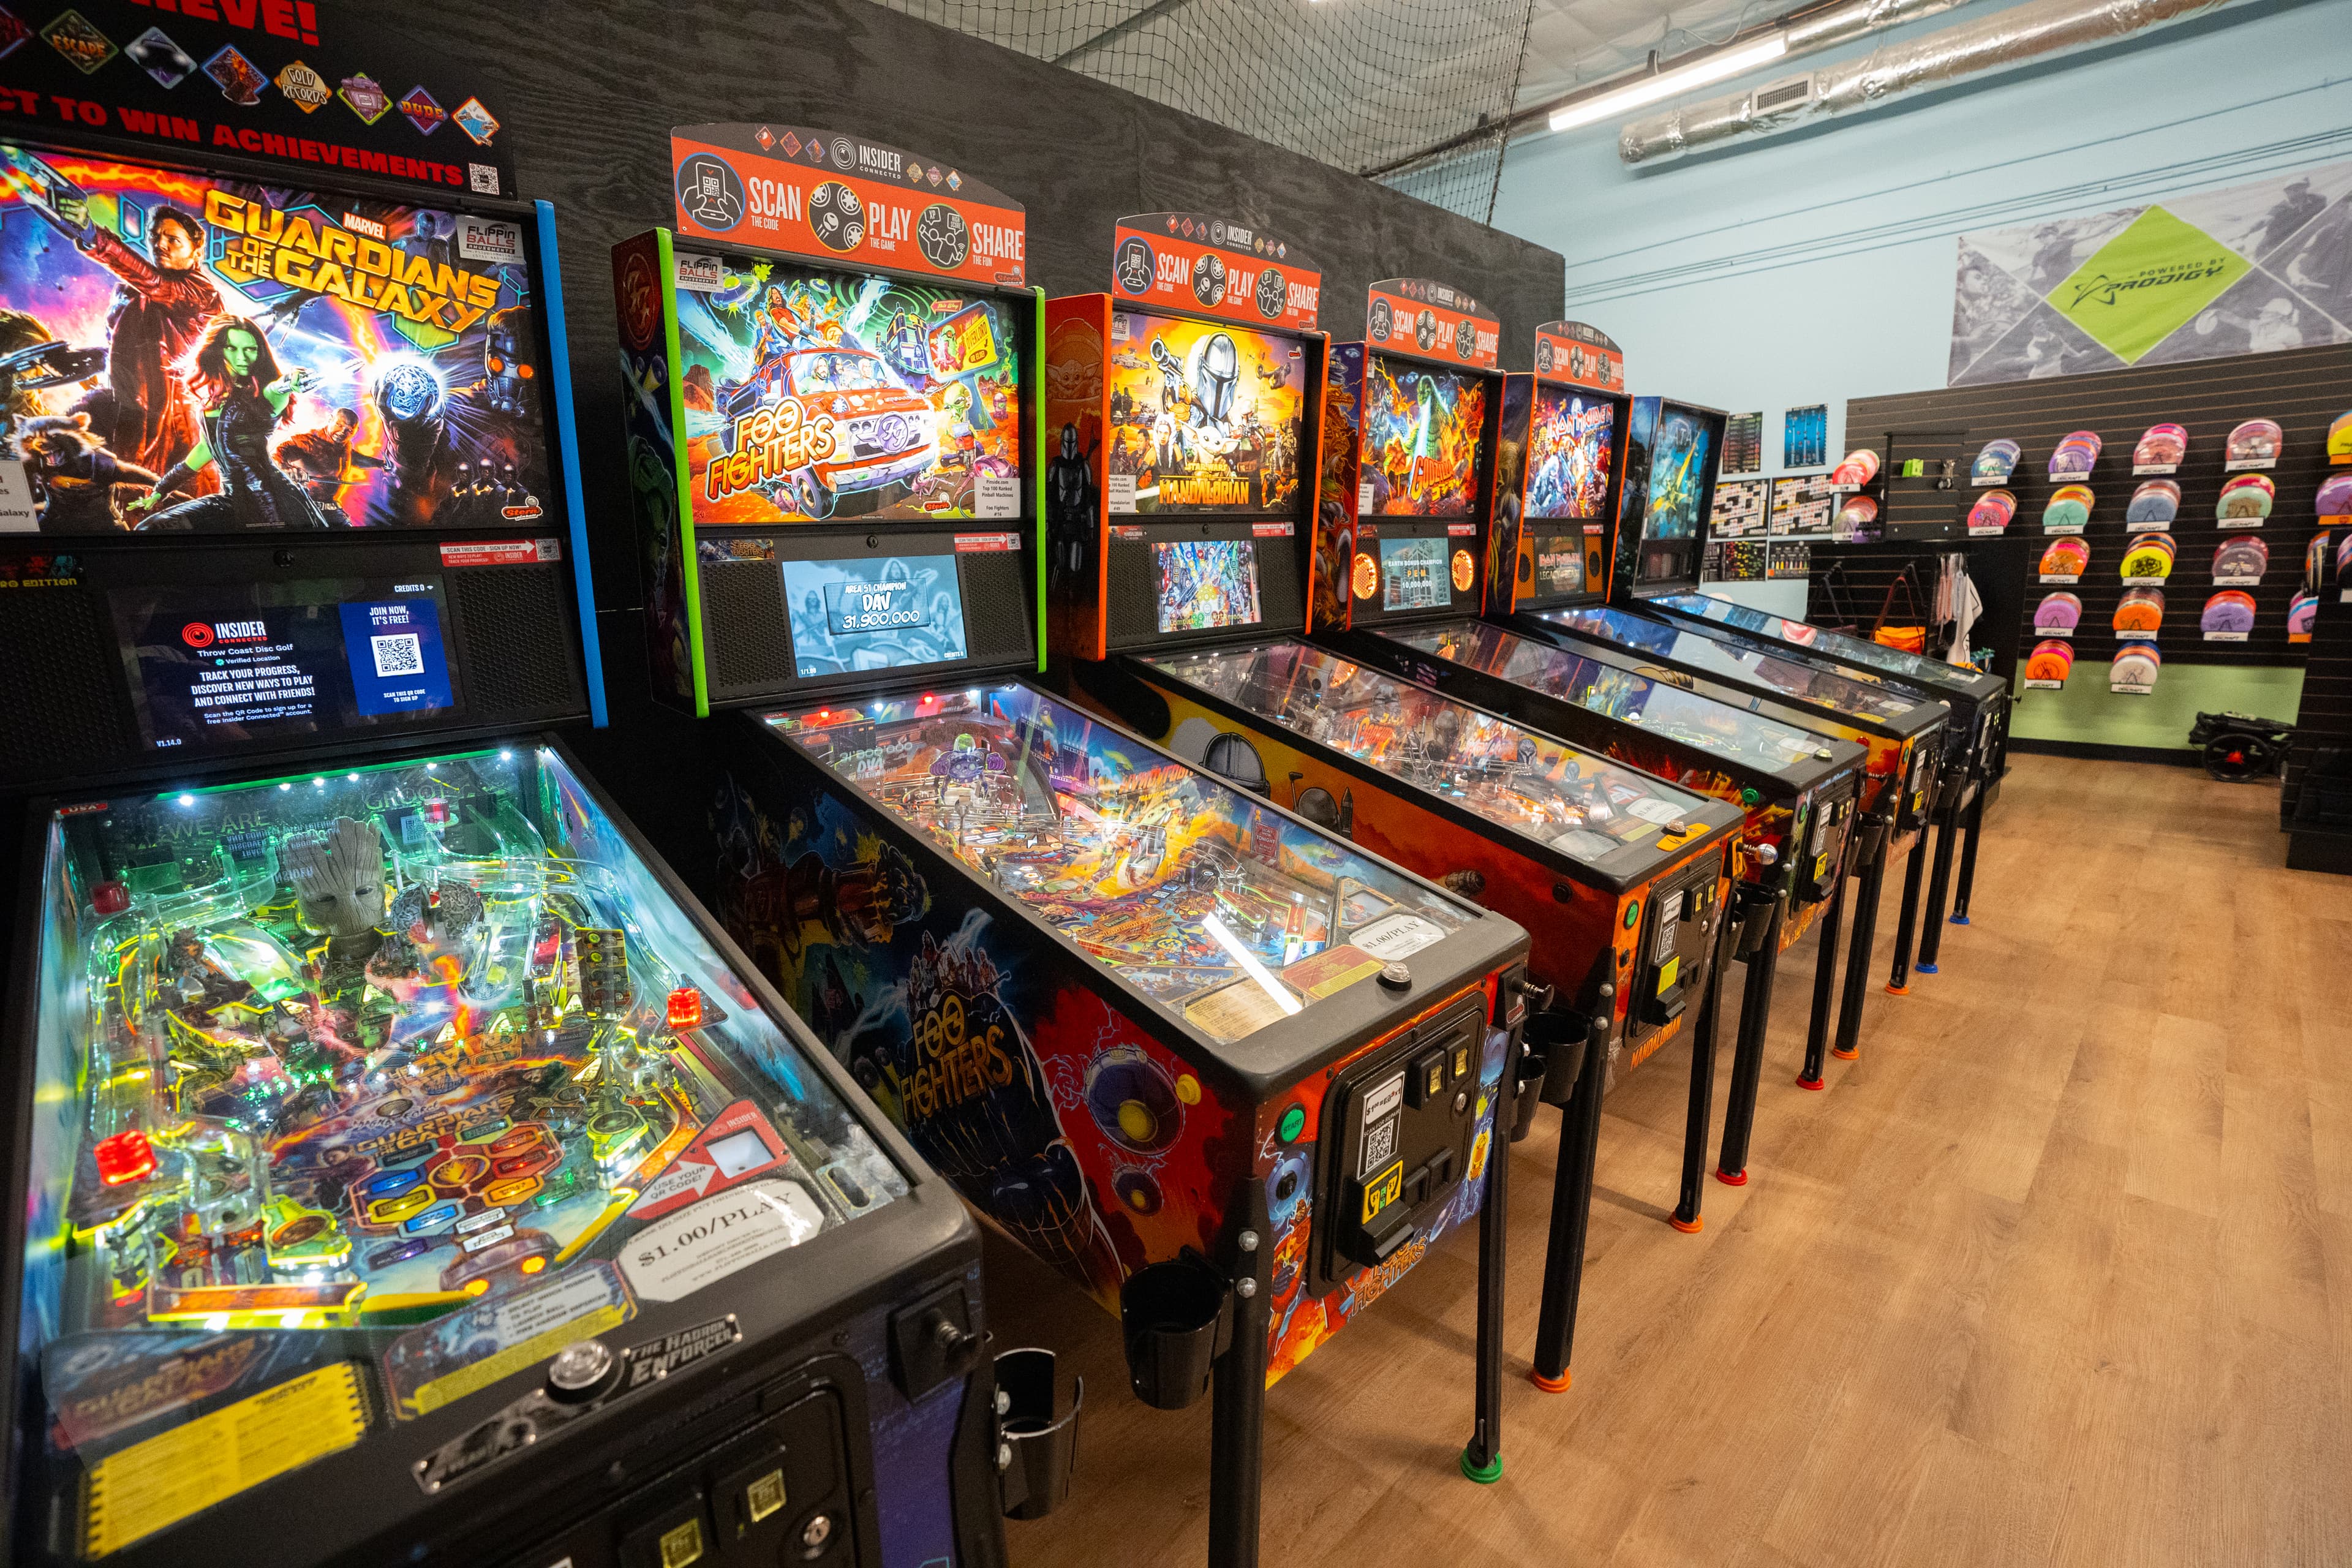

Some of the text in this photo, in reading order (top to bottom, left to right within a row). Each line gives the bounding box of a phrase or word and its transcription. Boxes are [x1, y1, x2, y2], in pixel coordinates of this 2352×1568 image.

[287, 67, 315, 87] GOLD
[282, 84, 328, 105] RECORDS
[401, 100, 445, 122] DUDE
[51, 96, 464, 186] TO WIN ACHIEVEMENTS
[859, 145, 901, 173] INSIDER
[859, 166, 902, 179] CONNECTED
[748, 176, 1023, 262] SCAN PLAY SHARE
[751, 215, 779, 231] THE CODE
[929, 210, 936, 220] XP
[344, 213, 386, 240] MARVEL
[467, 225, 515, 239] FLIPPIN
[1227, 225, 1253, 246] INSIDER
[204, 189, 502, 309] GUARDIANS
[242, 236, 277, 260] OF
[467, 234, 515, 248] BALLS
[468, 244, 513, 254] AMUSEMENTS
[870, 237, 896, 252] THE GAME
[680, 260, 718, 271] FLIPPIN
[973, 254, 992, 267] THE FUN
[2139, 262, 2203, 277] POWERED
[680, 267, 718, 279] BALLS
[1156, 252, 1319, 312] SCAN PLAY SHARE
[2104, 266, 2224, 293] PRODIGY
[226, 248, 486, 333] THE GALAXY
[1437, 287, 1454, 303] INSIDER
[965, 321, 988, 350] OVERLORD
[1393, 309, 1498, 353] SCAN PLAY SHARE
[1554, 346, 1624, 379] SCAN PLAY SHARE
[737, 399, 802, 452] FOO
[1546, 415, 1574, 440] IRON
[1574, 403, 1615, 434] MAIDEN
[708, 417, 835, 499] FIGHTERS
[1184, 462, 1228, 472] STAR WARS
[1411, 455, 1454, 501] GODZILLA
[1158, 480, 1250, 505] MANDALORIAN
[507, 508, 540, 517] Stern
[733, 548, 765, 556] FIGHTERS
[1538, 552, 1581, 569] IRON MAIDEN
[23, 577, 77, 589] EDITION
[1402, 580, 1432, 589] 10,000,000
[1539, 570, 1561, 580] LEGACY
[394, 584, 420, 593] CREDITS
[845, 581, 907, 594] AREA 51 CHAMPION
[369, 605, 409, 616] JOIN NOW,
[862, 591, 892, 612] DAV
[372, 614, 409, 625] IT'S FREE!
[842, 609, 921, 630] 31,900,000
[215, 621, 267, 639] INSIDER
[200, 665, 301, 682] TRACK YOUR PROGRESS,
[190, 676, 314, 695] DISCOVER NEW WAYS TO PLAY
[195, 687, 315, 707] AND CONNECT WITH FRIENDS!
[156, 738, 183, 748] V1.14.0
[69, 804, 97, 813] USA
[221, 809, 270, 833] ARE
[1256, 835, 1276, 844] TONIGHT
[1362, 920, 1420, 949] $1.00/PLAY
[913, 994, 965, 1066] FOO
[1629, 1014, 1682, 1072] MANDALORIAN
[900, 1024, 1012, 1128] FIGHTERS
[726, 1111, 758, 1128] INSIDER
[1283, 1117, 1303, 1134] START
[1363, 1126, 1378, 1138] SCAN
[1385, 1109, 1400, 1123] REPAIR
[649, 1174, 703, 1200] QR CODE!
[653, 1164, 707, 1191] USE YOUR
[638, 1191, 793, 1268] $1.00/PLAY
[631, 1319, 726, 1363] THE HADRON
[629, 1327, 733, 1387] ENFORCER
